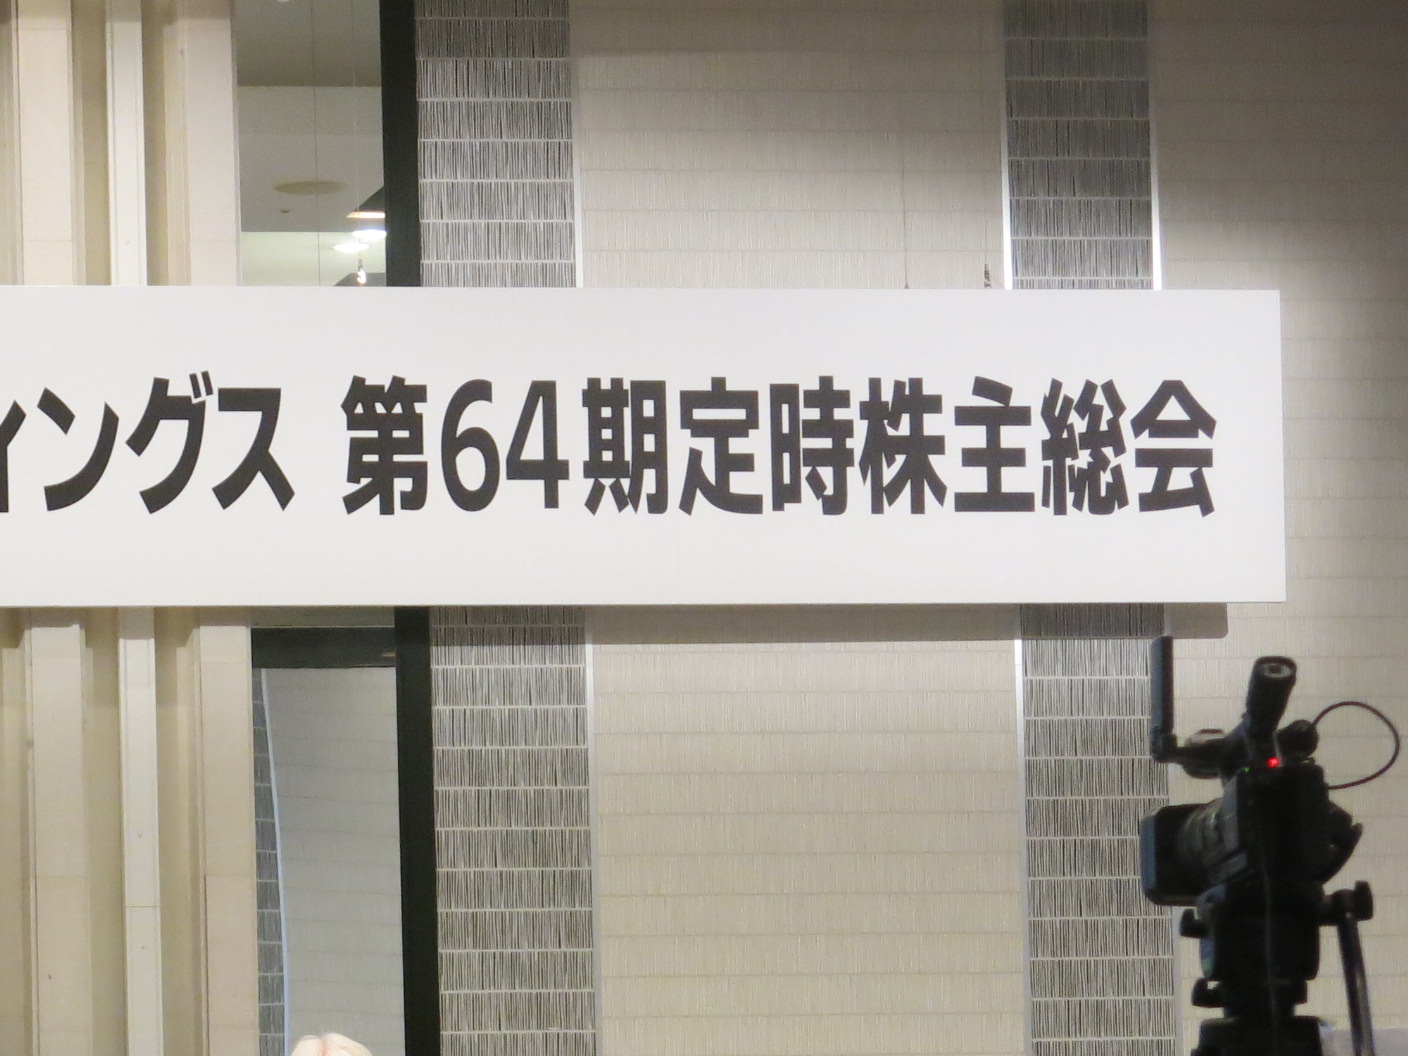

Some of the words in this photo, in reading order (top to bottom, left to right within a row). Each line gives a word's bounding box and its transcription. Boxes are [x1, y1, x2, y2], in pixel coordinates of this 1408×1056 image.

[342, 376, 1215, 516] 第64期定時株主総会
